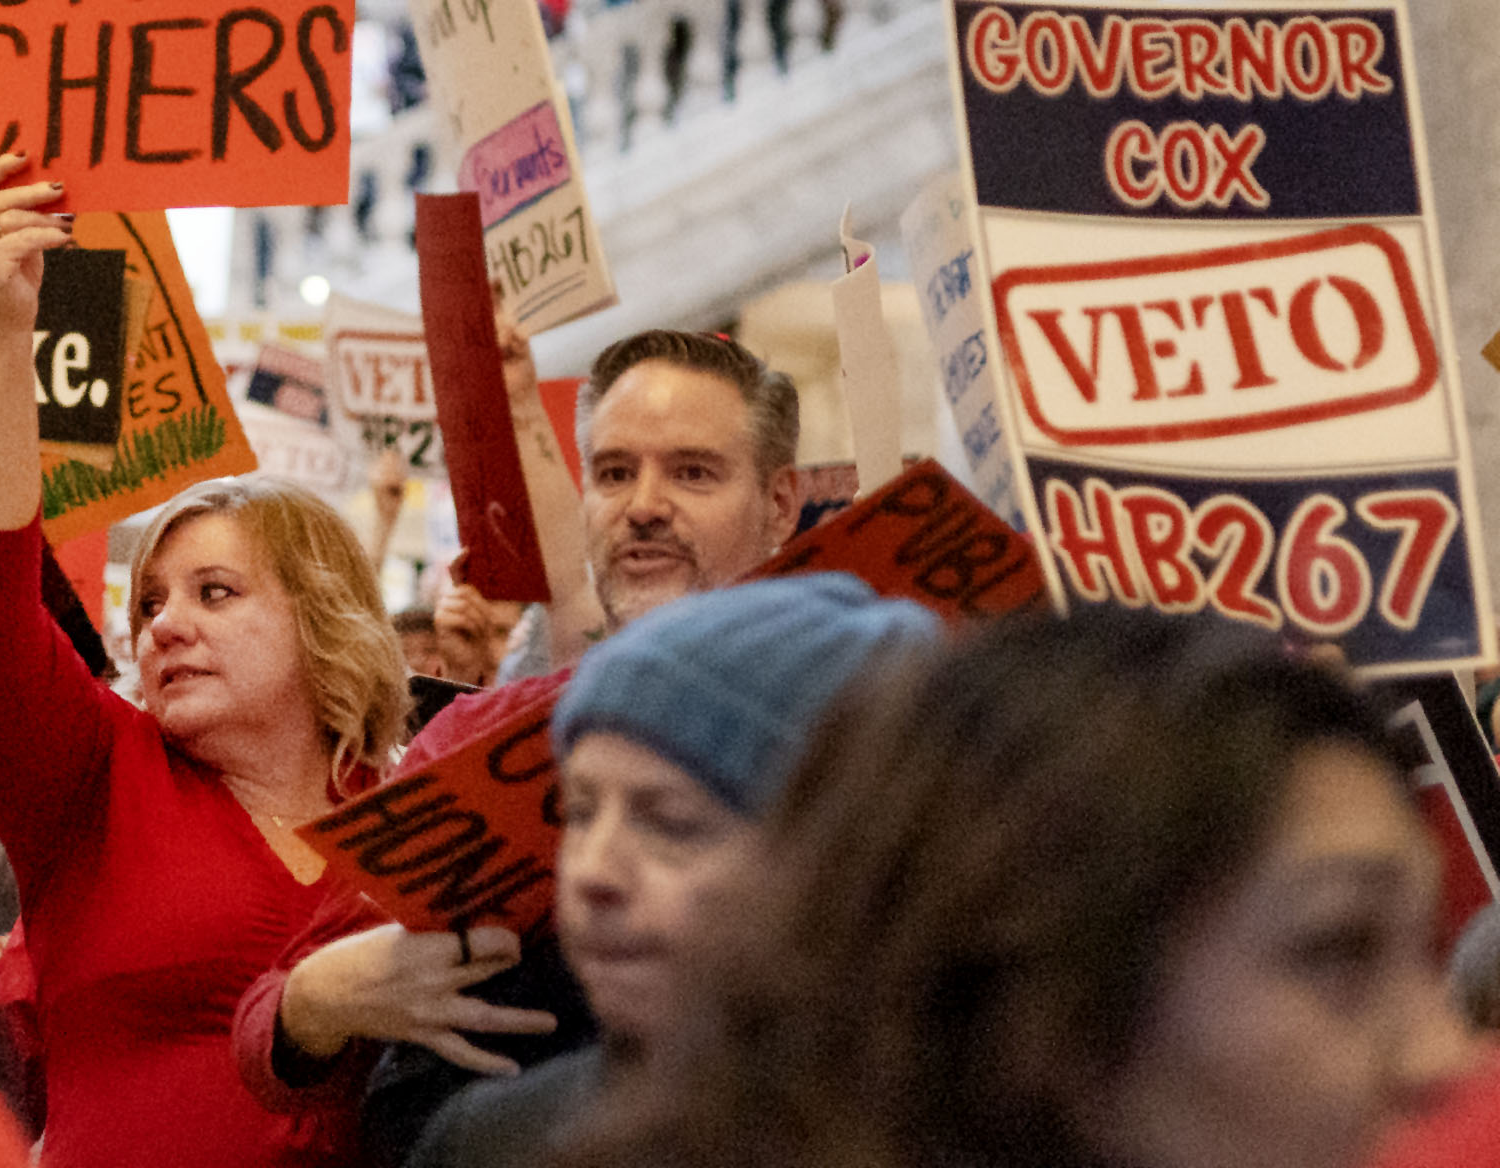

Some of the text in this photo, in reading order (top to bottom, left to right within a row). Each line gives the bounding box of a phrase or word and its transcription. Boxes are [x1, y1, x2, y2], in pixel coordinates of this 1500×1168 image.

[966, 6, 1393, 102] GOVERNOR
[1105, 119, 1272, 208] COX
[490, 206, 589, 298] HB267
[1026, 275, 1386, 406] VETO
[1044, 478, 1459, 634] HB267
